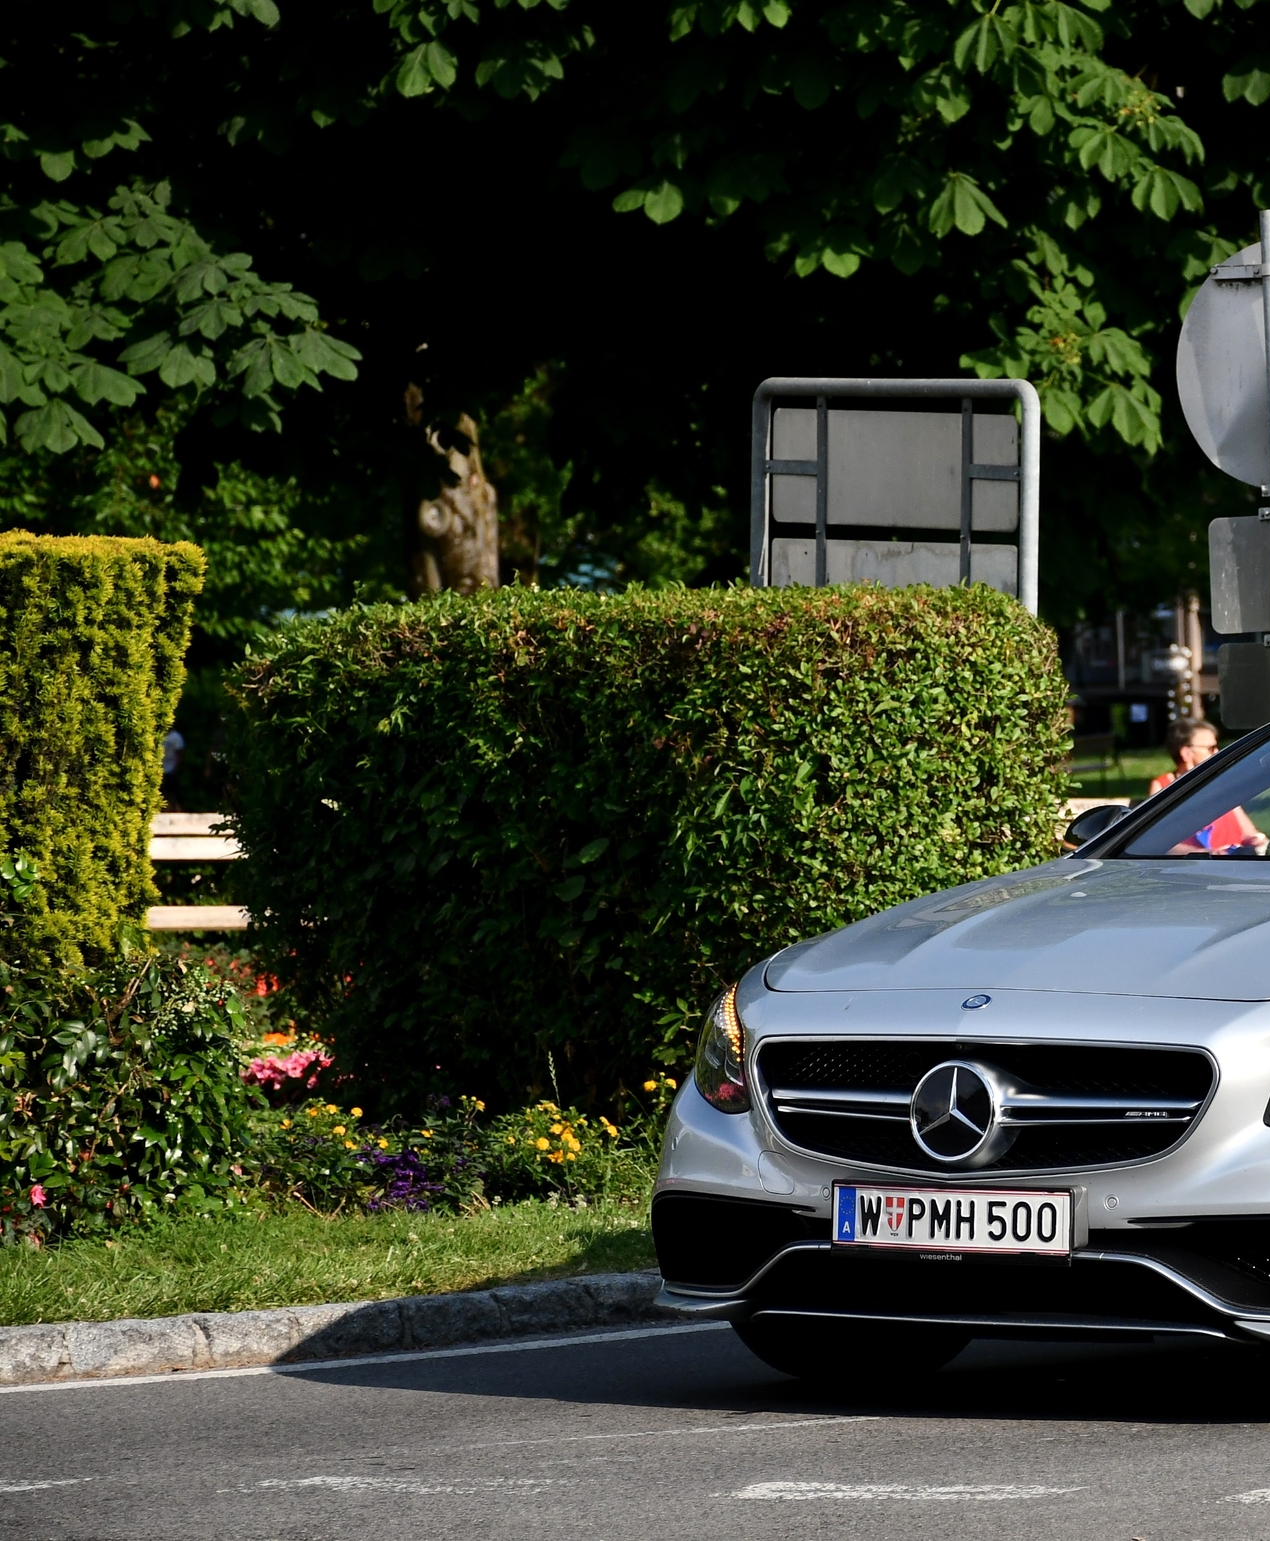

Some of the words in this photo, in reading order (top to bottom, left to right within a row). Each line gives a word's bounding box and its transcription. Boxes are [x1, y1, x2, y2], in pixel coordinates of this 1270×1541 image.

[860, 1195, 882, 1236] W
[907, 1198, 975, 1240] PMH
[988, 1201, 1058, 1242] 500
[842, 1221, 851, 1233] A
[919, 1253, 962, 1262] wiesenthal
